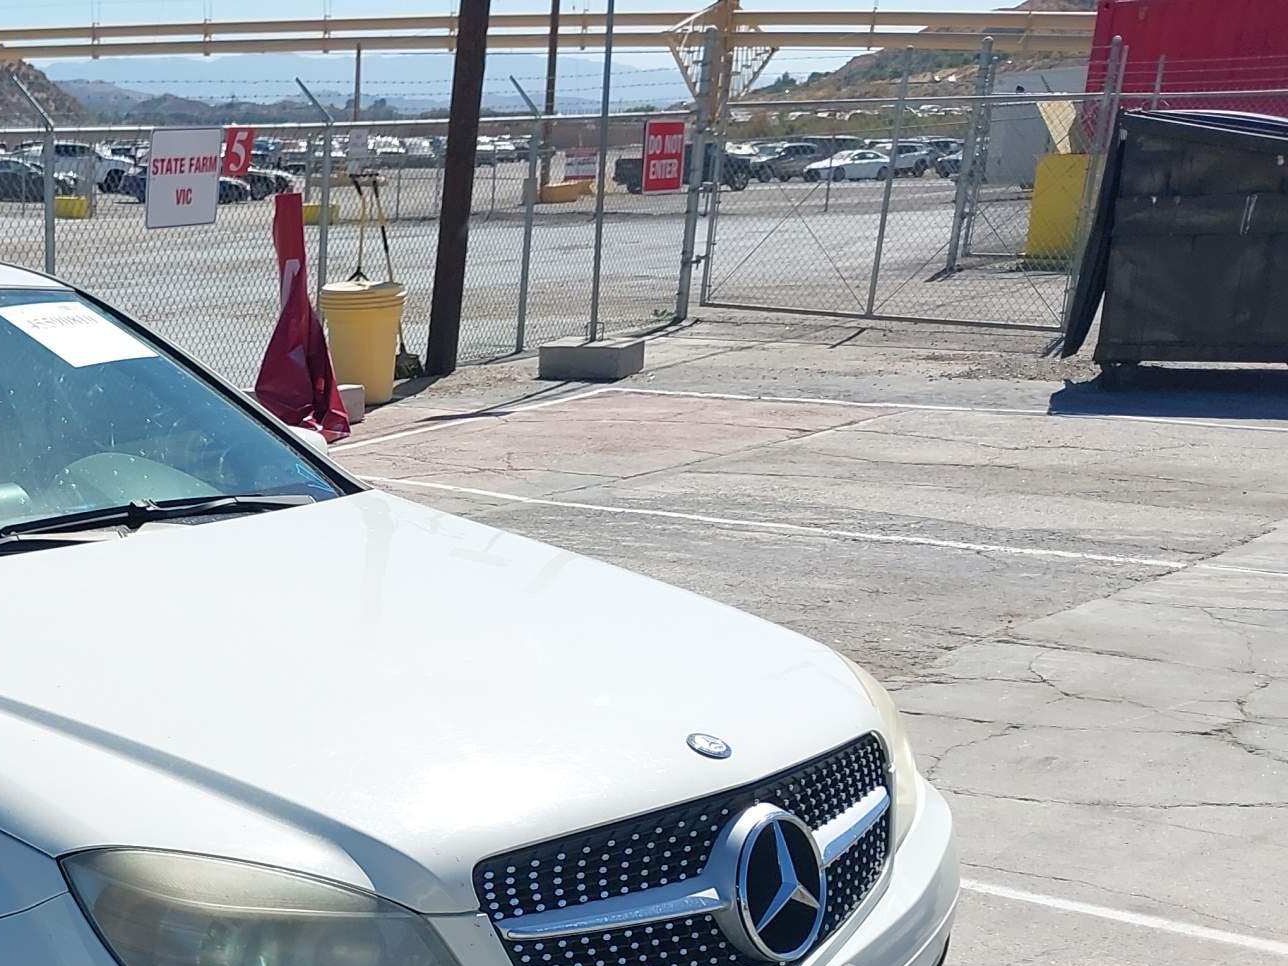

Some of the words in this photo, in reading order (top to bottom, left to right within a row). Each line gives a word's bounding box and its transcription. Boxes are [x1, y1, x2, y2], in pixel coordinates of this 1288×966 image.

[229, 131, 249, 172] 5
[648, 135, 663, 155] DO
[664, 134, 683, 155] NOT
[152, 158, 185, 176] STATE
[188, 156, 218, 174] FARM
[649, 159, 679, 179] ENTER
[175, 188, 193, 206] VIC
